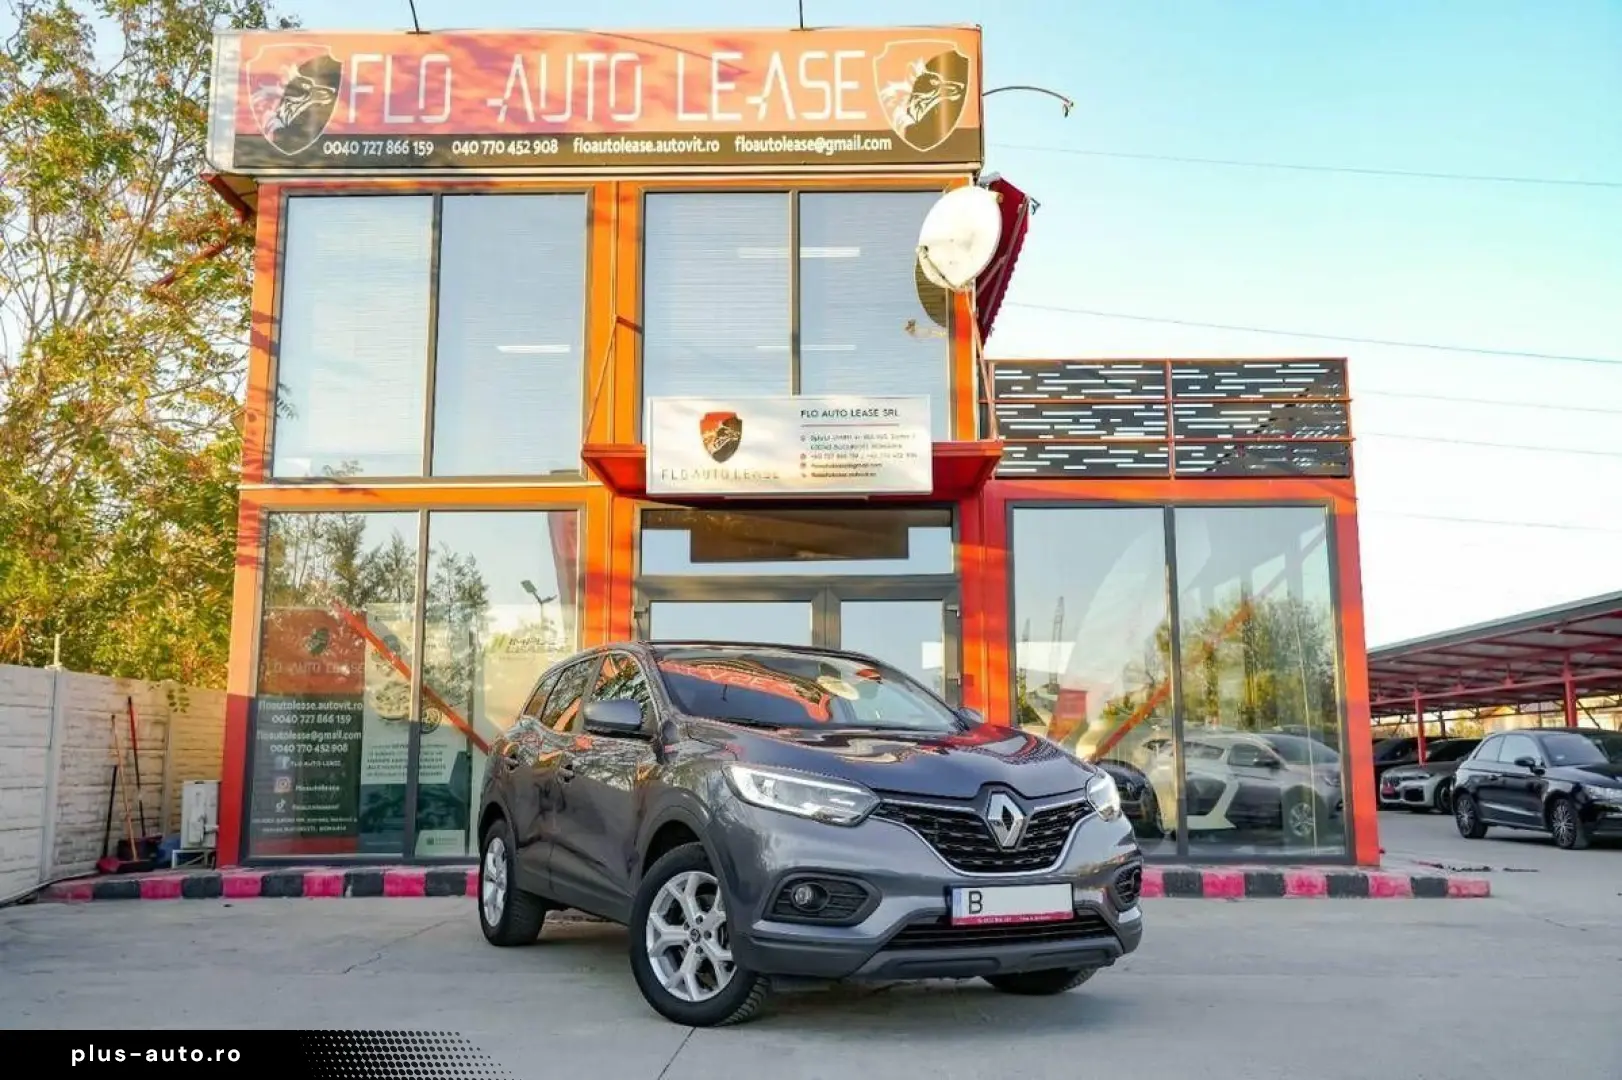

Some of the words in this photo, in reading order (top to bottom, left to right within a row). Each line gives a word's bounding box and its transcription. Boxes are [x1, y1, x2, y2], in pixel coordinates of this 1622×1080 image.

[348, 53, 451, 124] FLO
[486, 52, 642, 123] AUTO
[677, 50, 867, 122] LEASE
[322, 141, 359, 155] 0040
[362, 141, 384, 157] 727
[387, 140, 409, 155] 866
[412, 141, 435, 156] 159
[452, 140, 479, 155] 040
[482, 140, 505, 155] 770
[507, 140, 531, 155] 452
[533, 139, 559, 155] 908
[573, 136, 720, 154] floautolease.autovit.ro
[734, 134, 893, 154] floautolease@gmail.com
[800, 410, 819, 418] FLO
[822, 410, 848, 418] AUTO
[851, 409, 880, 417] LEASE
[883, 409, 900, 417] SRL
[661, 468, 688, 481] FLO
[691, 468, 730, 481] AUTO
[968, 890, 983, 915] B
